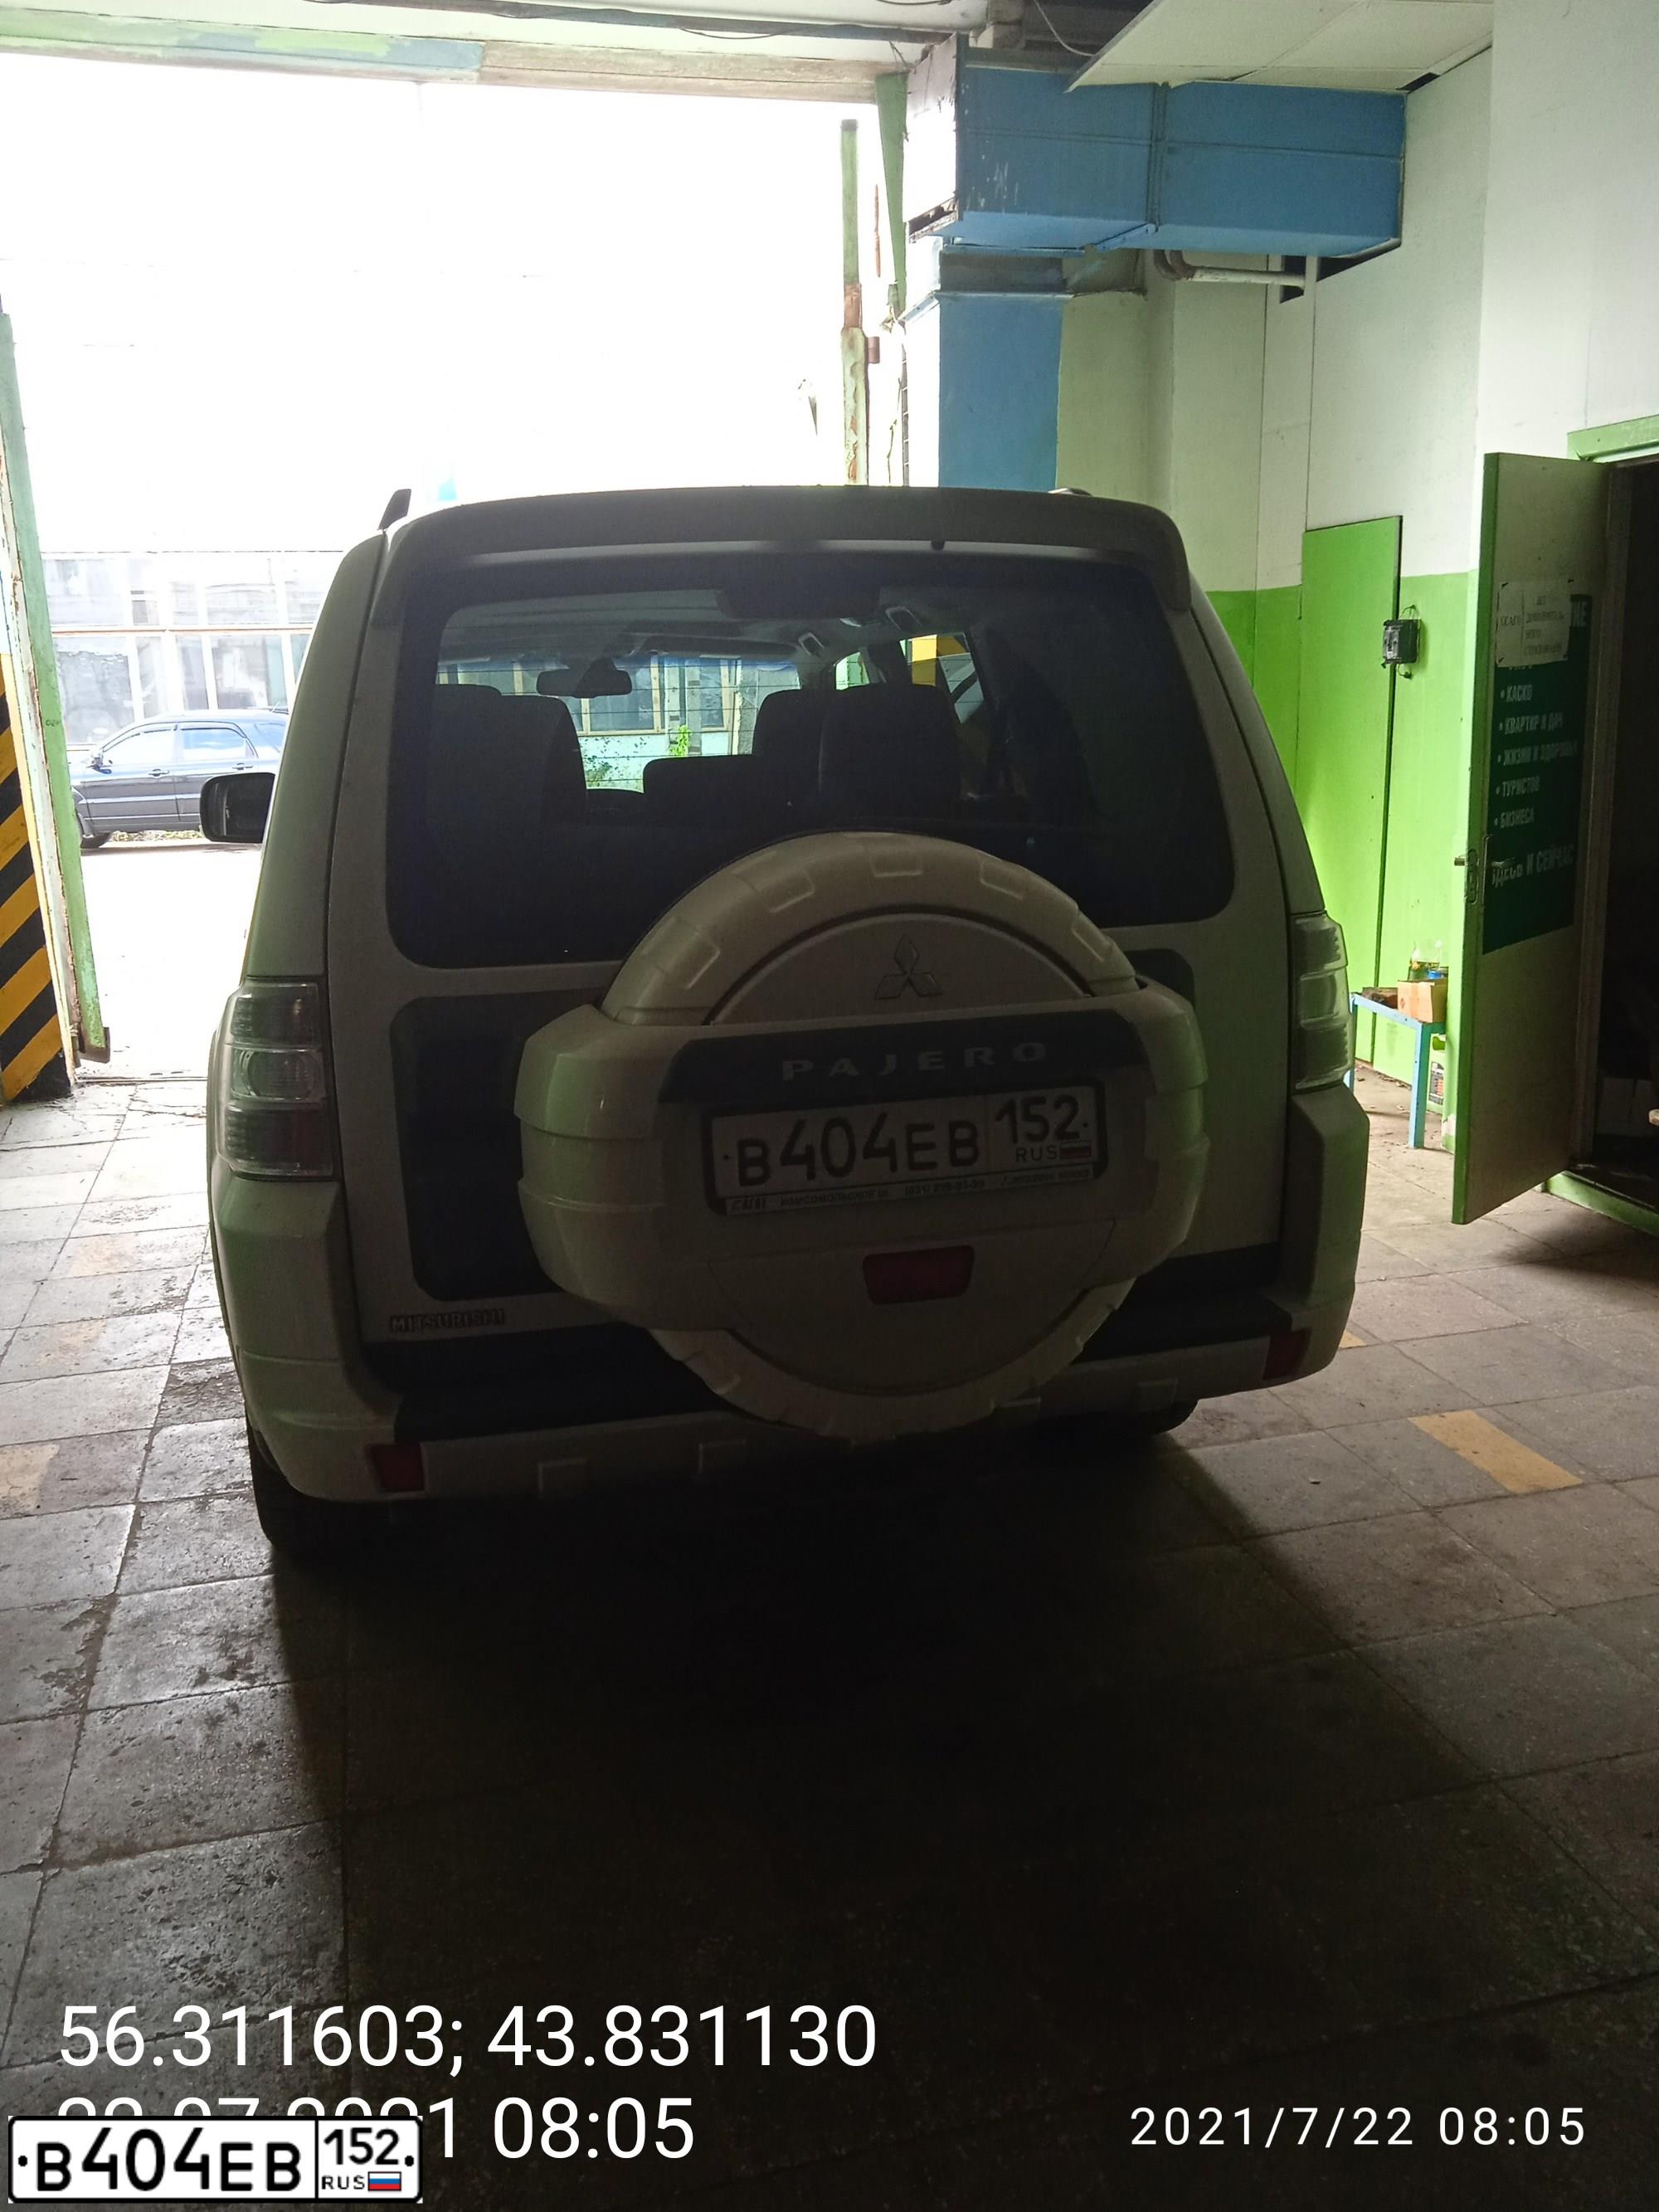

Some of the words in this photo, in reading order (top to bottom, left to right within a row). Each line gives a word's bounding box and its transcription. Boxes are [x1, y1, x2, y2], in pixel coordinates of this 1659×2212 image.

[1506, 685, 1533, 703] КАСКО
[782, 1041, 1046, 1080] PAJERO
[995, 1094, 1080, 1144] 152
[1015, 1144, 1057, 1162] RUS
[390, 1308, 505, 1333] MITSUBISHI
